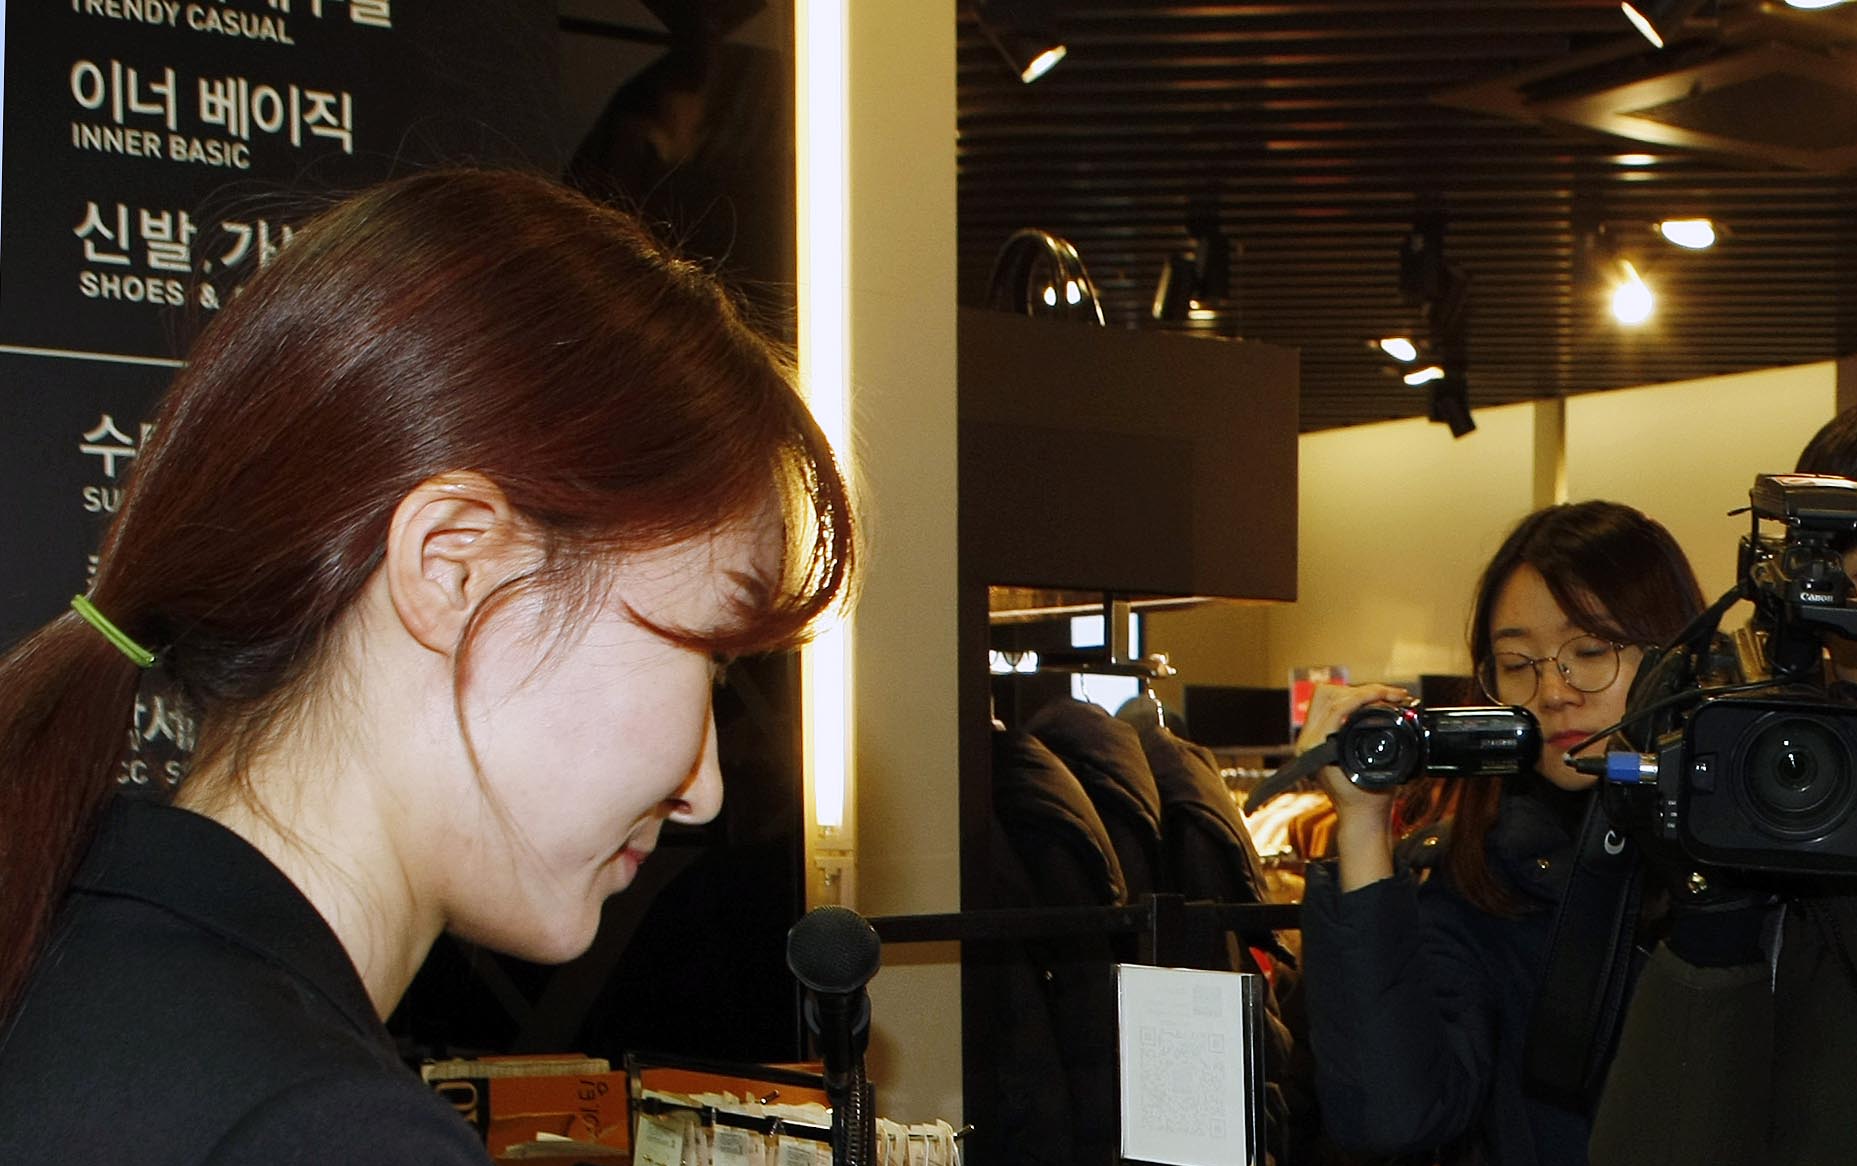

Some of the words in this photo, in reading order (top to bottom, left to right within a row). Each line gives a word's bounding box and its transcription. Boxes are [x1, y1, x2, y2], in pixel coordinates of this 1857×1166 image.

[187, 7, 296, 46] CASUAL
[70, 60, 178, 131] 이너
[200, 77, 354, 155] 베이직
[72, 122, 162, 159] INNER
[168, 134, 252, 170] BASIC
[79, 269, 185, 307] SHOES
[198, 281, 221, 310] &
[1800, 592, 1834, 603] Canon
